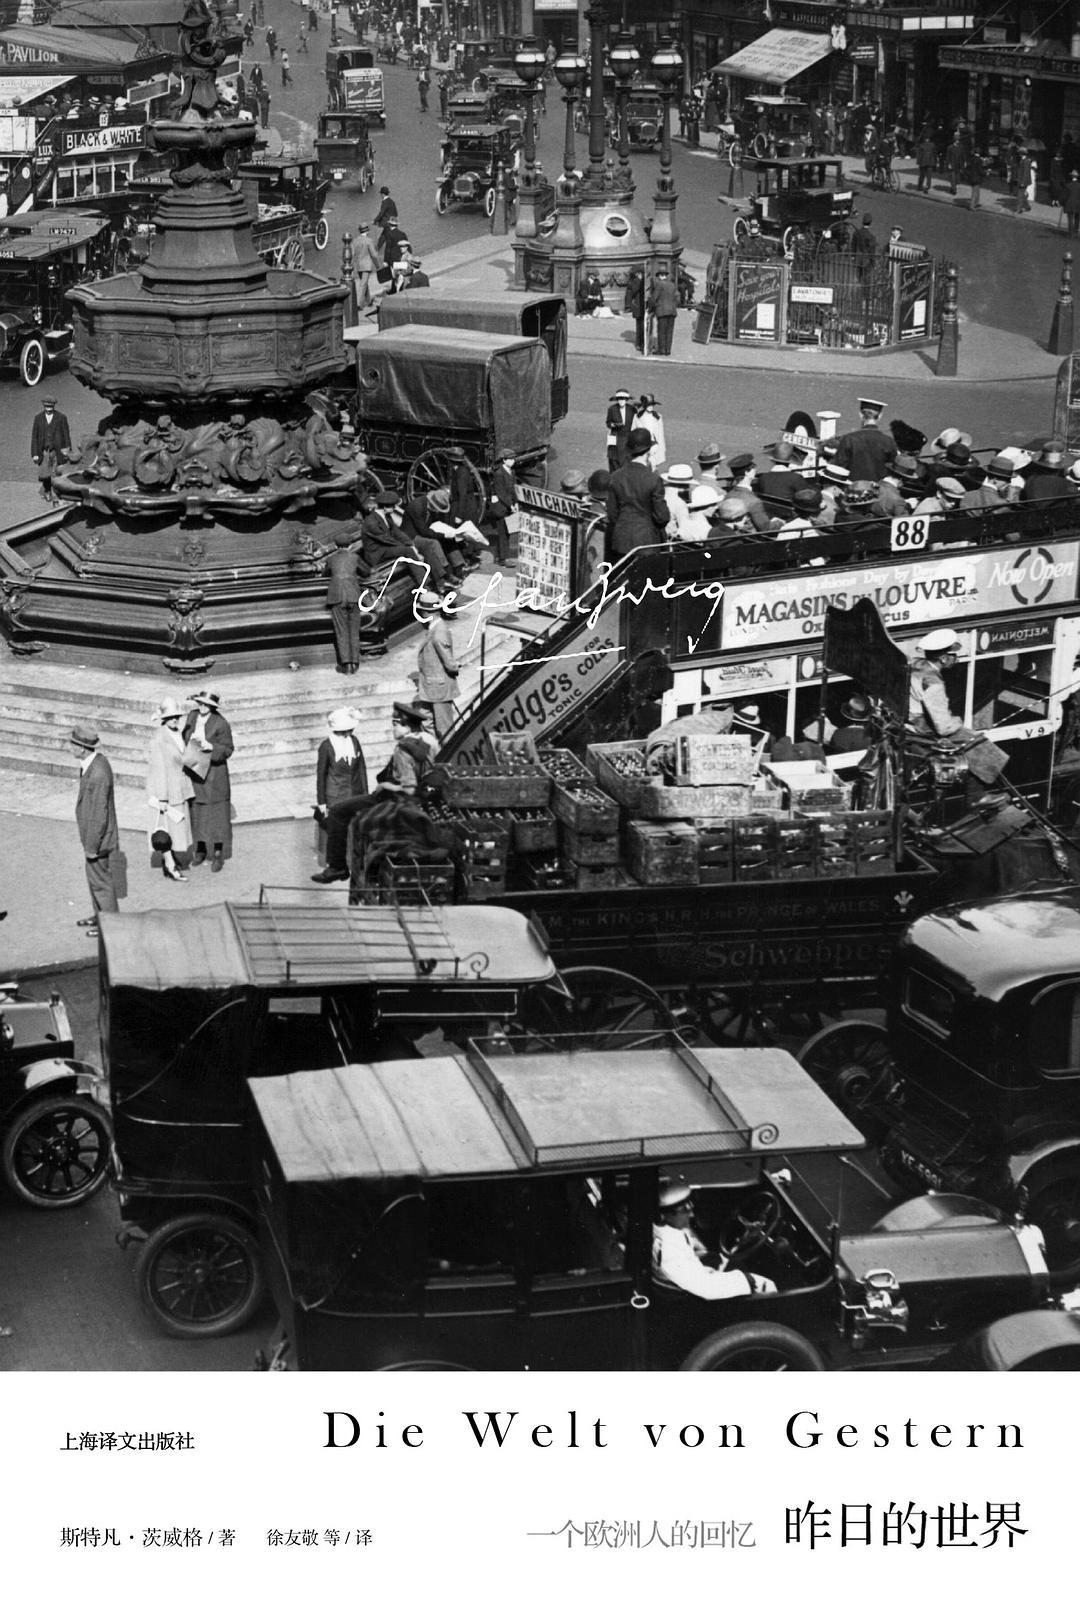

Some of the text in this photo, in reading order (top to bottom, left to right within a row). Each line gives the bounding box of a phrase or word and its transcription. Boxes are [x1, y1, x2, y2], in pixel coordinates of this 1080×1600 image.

[7, 43, 59, 62] PAVILION
[38, 145, 53, 156] LUX
[66, 131, 101, 149] BLACK
[110, 129, 142, 145] WHITE
[522, 487, 579, 519] MITCHAM
[895, 520, 925, 546] 88
[988, 556, 1074, 588] Now Open
[735, 592, 847, 626] MAGASINS
[874, 577, 966, 608] LOUVRE
[577, 637, 614, 677] COLDS
[548, 688, 583, 718] TONIC
[704, 942, 894, 969] Schweppes
